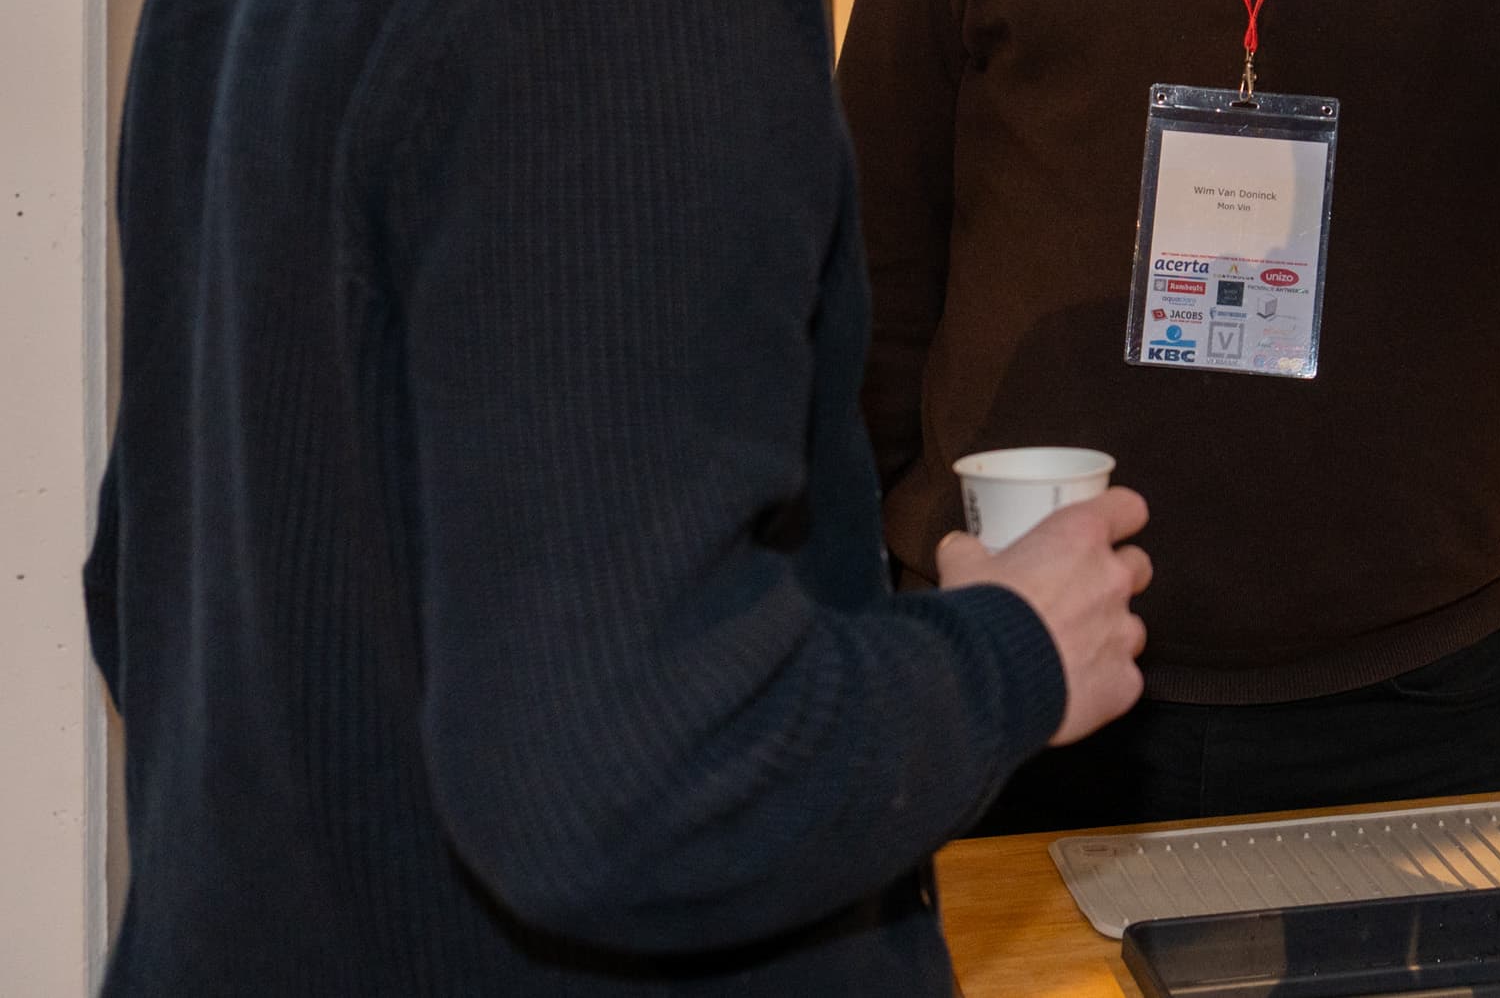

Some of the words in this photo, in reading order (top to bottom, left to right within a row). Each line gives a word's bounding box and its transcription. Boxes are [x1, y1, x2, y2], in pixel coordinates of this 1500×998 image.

[1194, 186, 1215, 195] Wim
[1218, 188, 1236, 197] Van
[1239, 189, 1278, 201] Doninck
[1217, 202, 1235, 210] Mon
[1237, 203, 1251, 211] Vin
[1154, 258, 1209, 274] acerta
[1265, 271, 1294, 283] unizo
[1169, 310, 1203, 320] JACOBS
[1148, 347, 1195, 362] KBC
